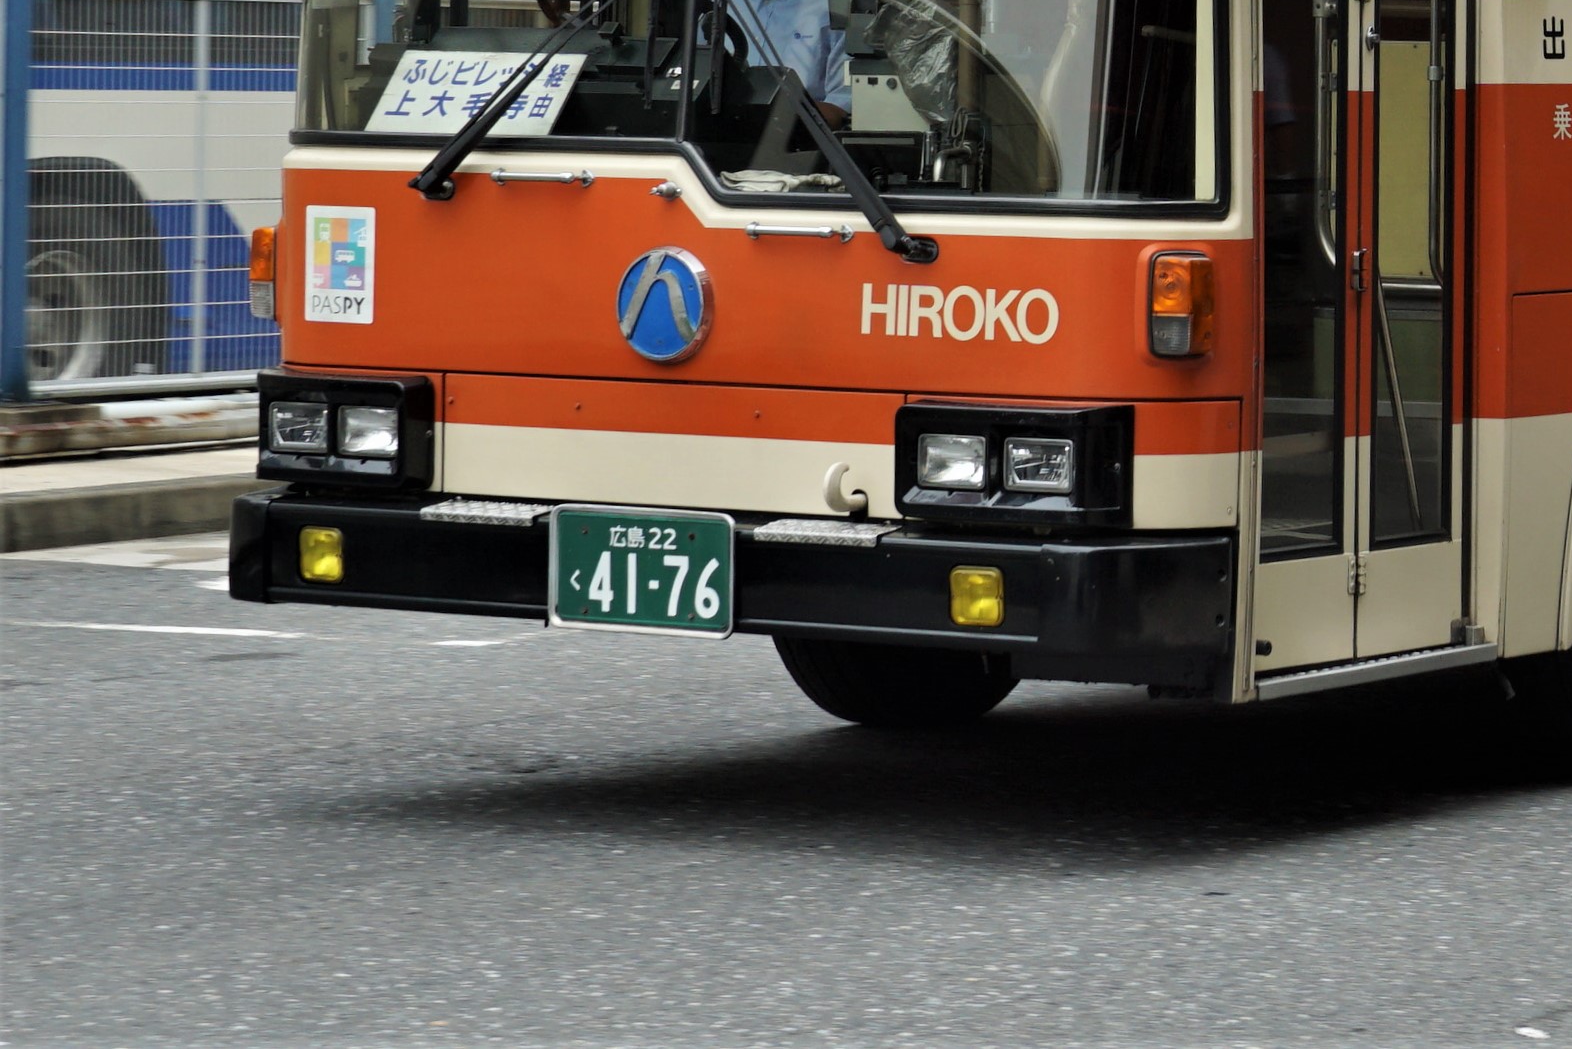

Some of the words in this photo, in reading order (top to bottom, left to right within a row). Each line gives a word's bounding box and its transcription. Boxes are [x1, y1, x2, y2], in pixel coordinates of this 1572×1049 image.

[311, 294, 366, 315] PASPY
[860, 283, 1059, 345] HIROKO
[588, 552, 721, 621] 41-76
